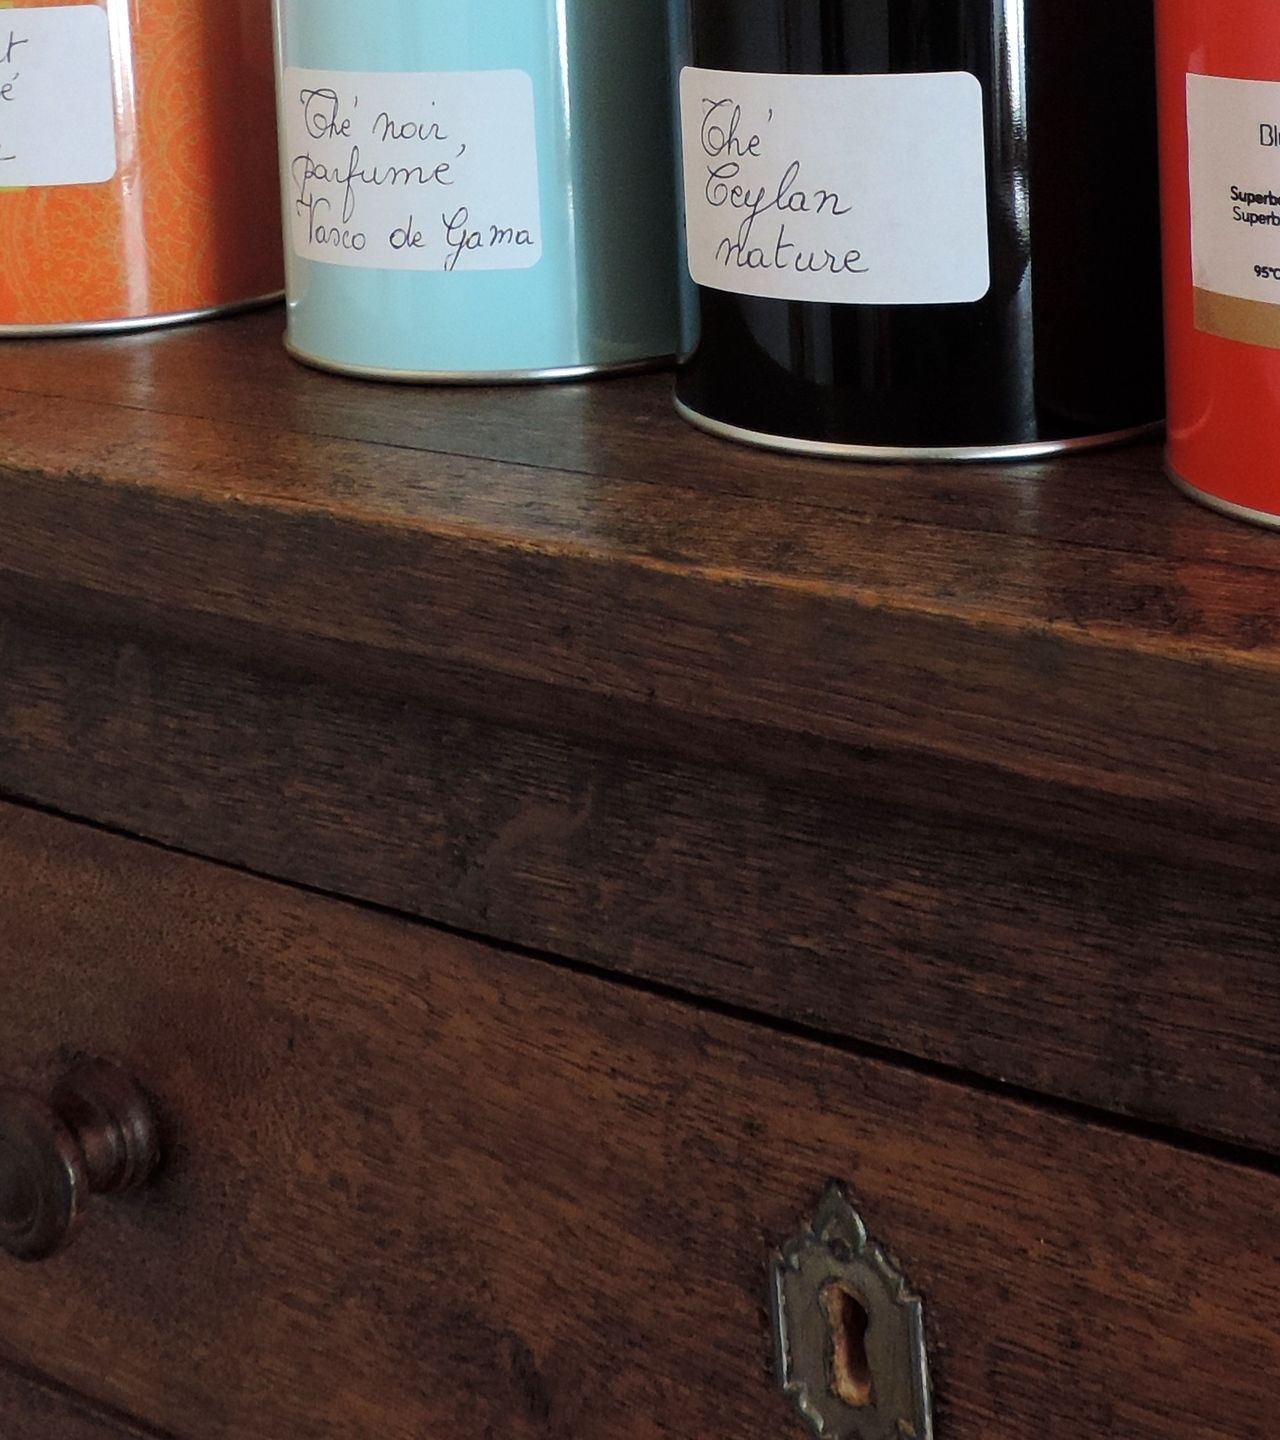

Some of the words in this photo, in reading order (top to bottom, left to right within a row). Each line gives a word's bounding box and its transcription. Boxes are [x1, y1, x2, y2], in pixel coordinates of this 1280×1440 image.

[300, 88, 358, 139] Thé
[372, 101, 449, 142] noir
[701, 98, 773, 157] Thé
[705, 160, 853, 245] Ceylan
[1232, 206, 1280, 228] Superb
[296, 193, 367, 251] Vasco
[389, 215, 426, 250] de
[442, 207, 535, 271] Gama
[715, 224, 870, 274] nature
